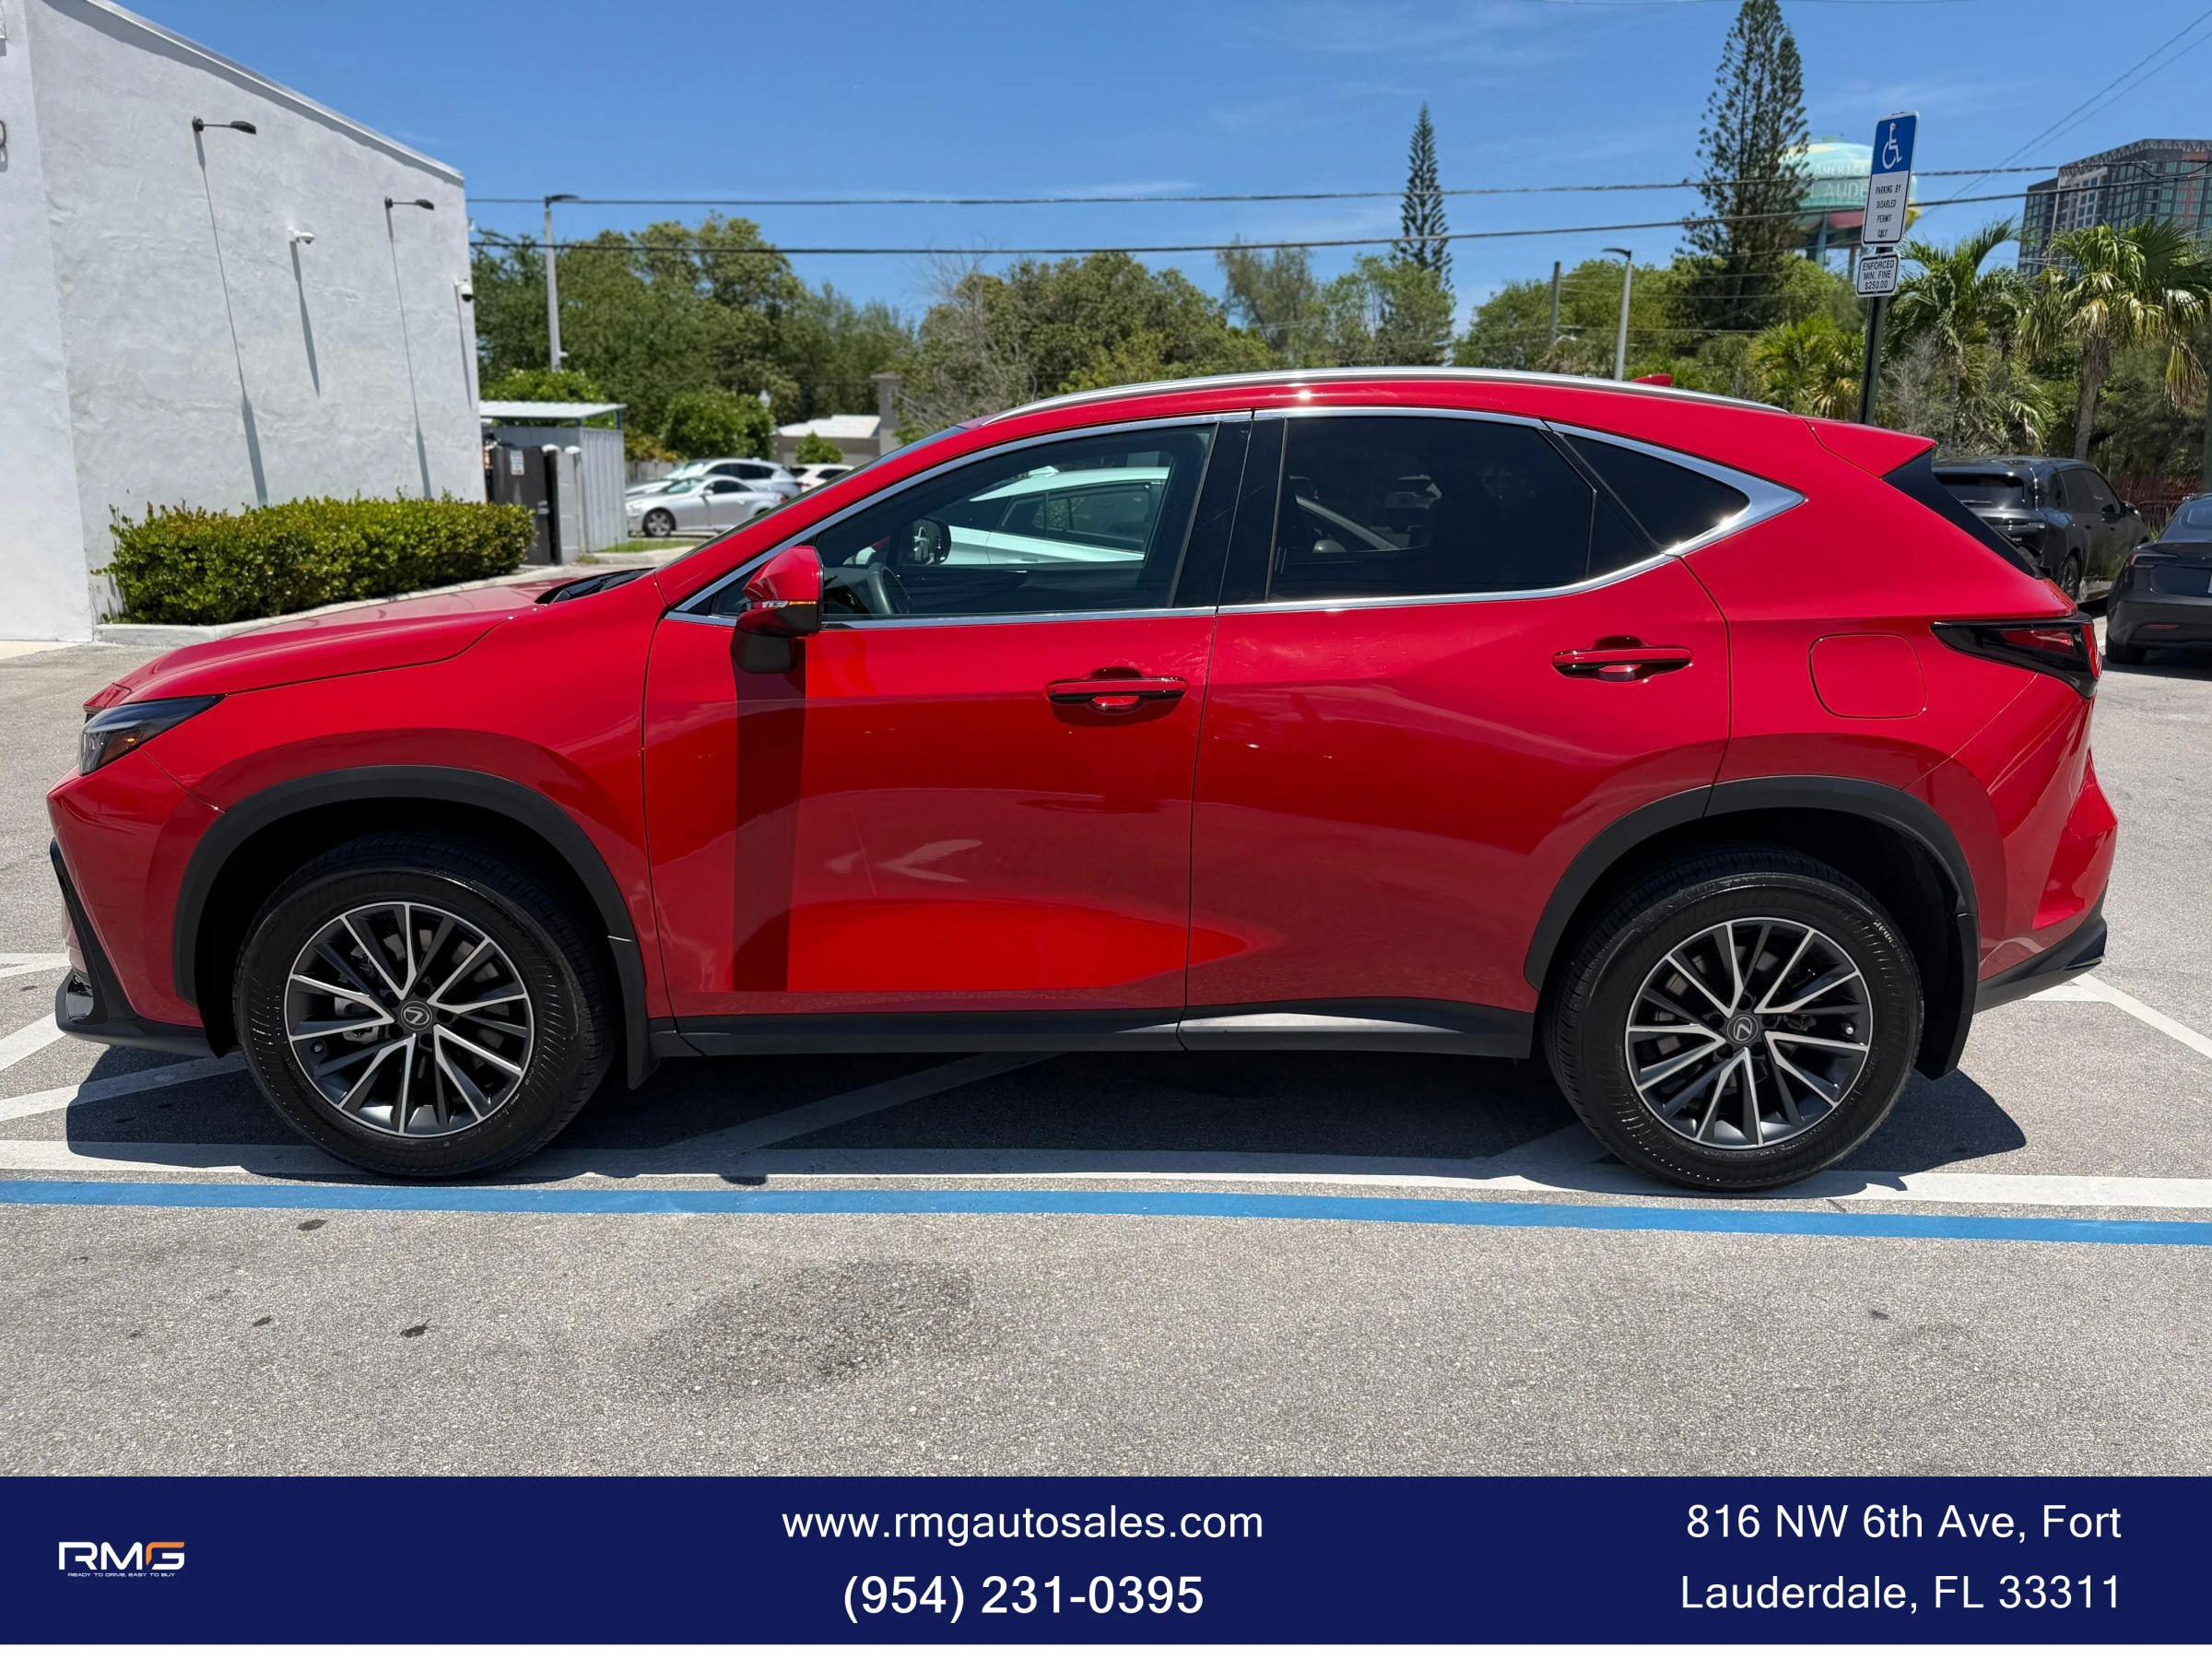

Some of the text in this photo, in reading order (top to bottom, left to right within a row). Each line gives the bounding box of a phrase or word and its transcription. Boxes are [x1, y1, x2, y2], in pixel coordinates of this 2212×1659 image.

[1875, 184, 1901, 194] PARKING BY
[1876, 199, 1897, 209] DISABLED
[1877, 214, 1892, 223] PERMIT
[1877, 229, 1888, 239] ONLY
[1862, 259, 1895, 271] ENFORCED
[1863, 269, 1892, 280] MIN. FINE
[1865, 279, 1888, 290] $250.00
